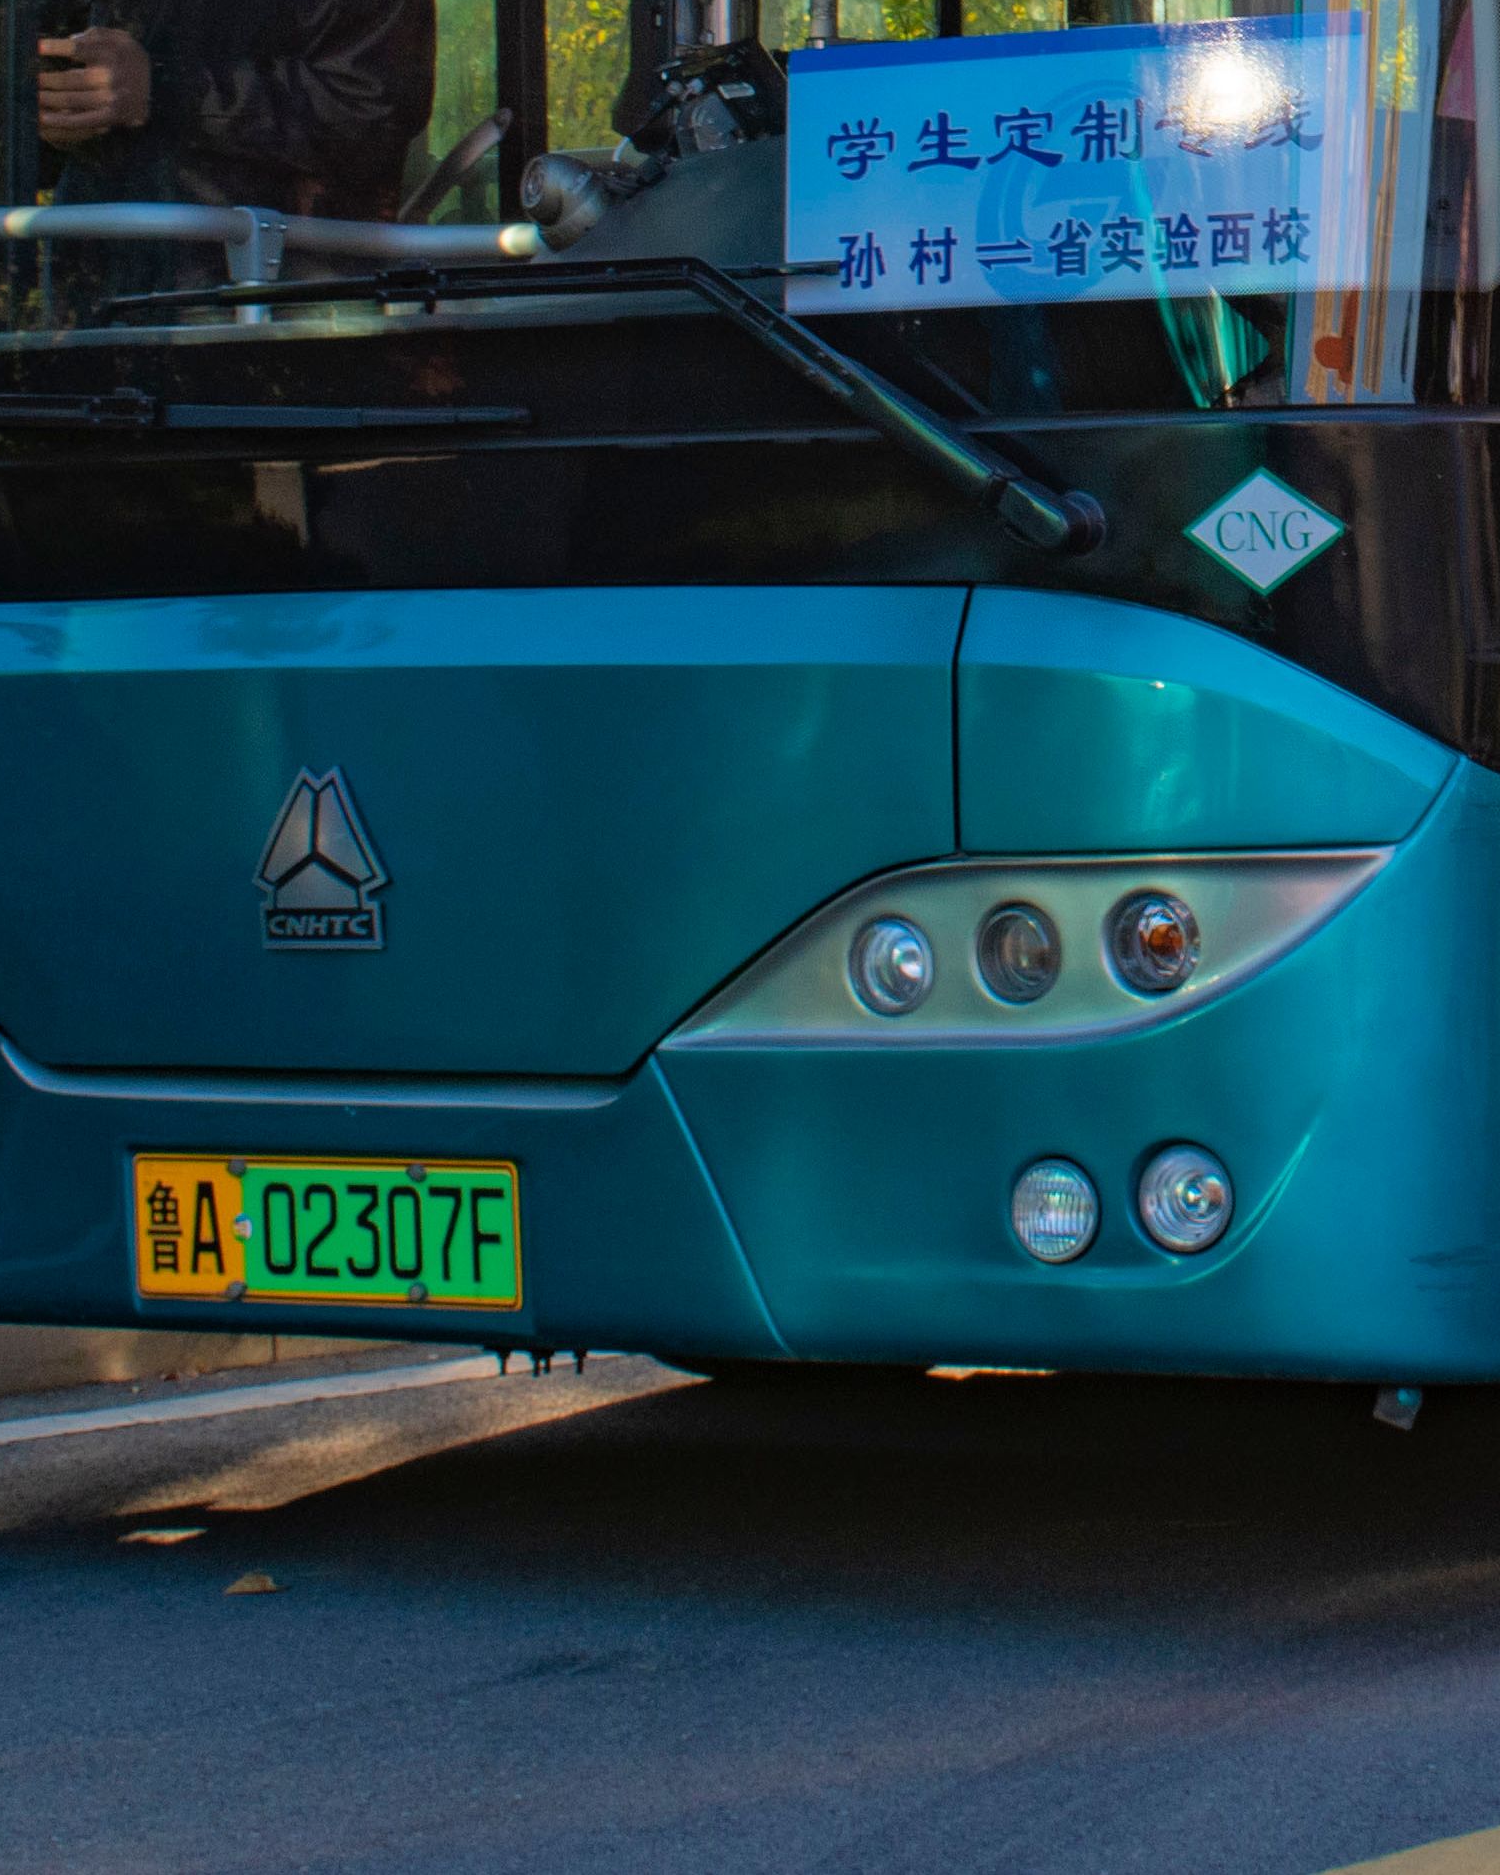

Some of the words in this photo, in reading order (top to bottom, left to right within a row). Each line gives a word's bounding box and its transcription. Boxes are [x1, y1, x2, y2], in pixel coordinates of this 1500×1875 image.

[827, 91, 1325, 181] 学生定制线
[837, 226, 958, 289] 孙村
[1047, 207, 1312, 277] 省实验西校
[1215, 510, 1314, 552] CNG
[267, 913, 371, 937] CNHTC
